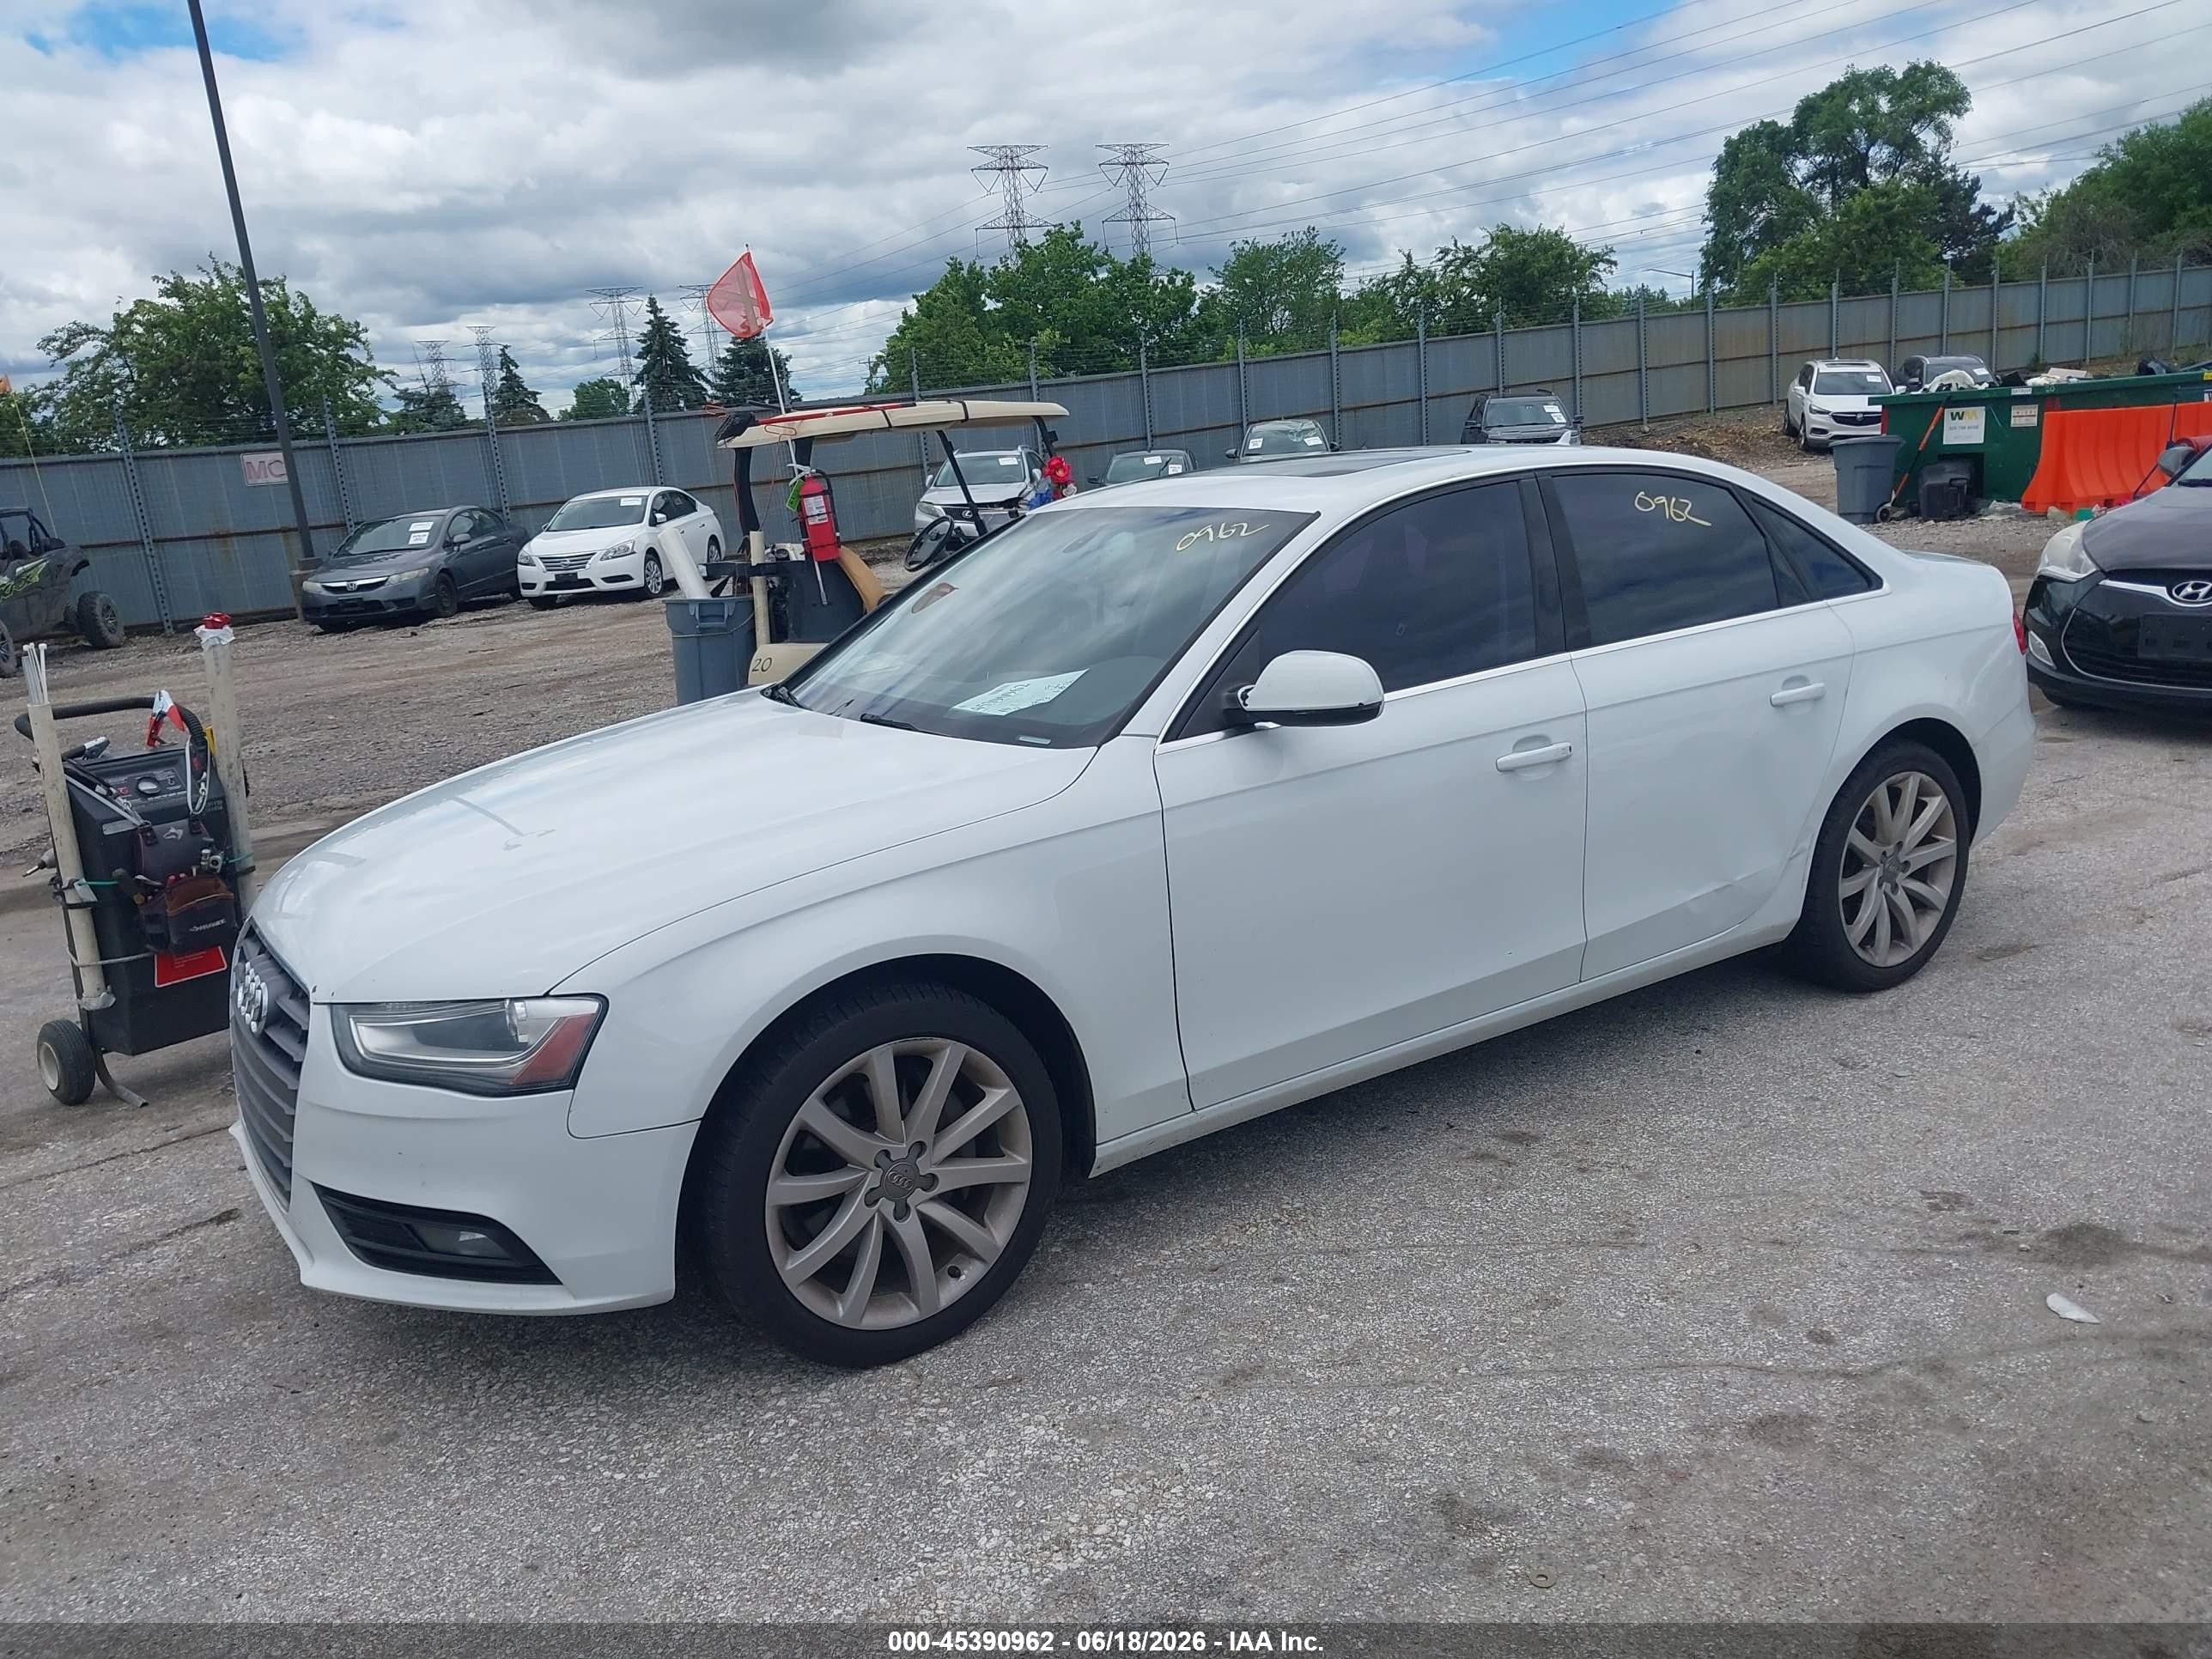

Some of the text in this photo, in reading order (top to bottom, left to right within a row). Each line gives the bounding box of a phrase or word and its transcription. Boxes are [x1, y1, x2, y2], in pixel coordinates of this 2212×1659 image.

[1950, 410, 1978, 421] WM
[1634, 491, 1712, 526] 0962
[1176, 522, 1271, 551] 0962
[751, 657, 773, 672] 20
